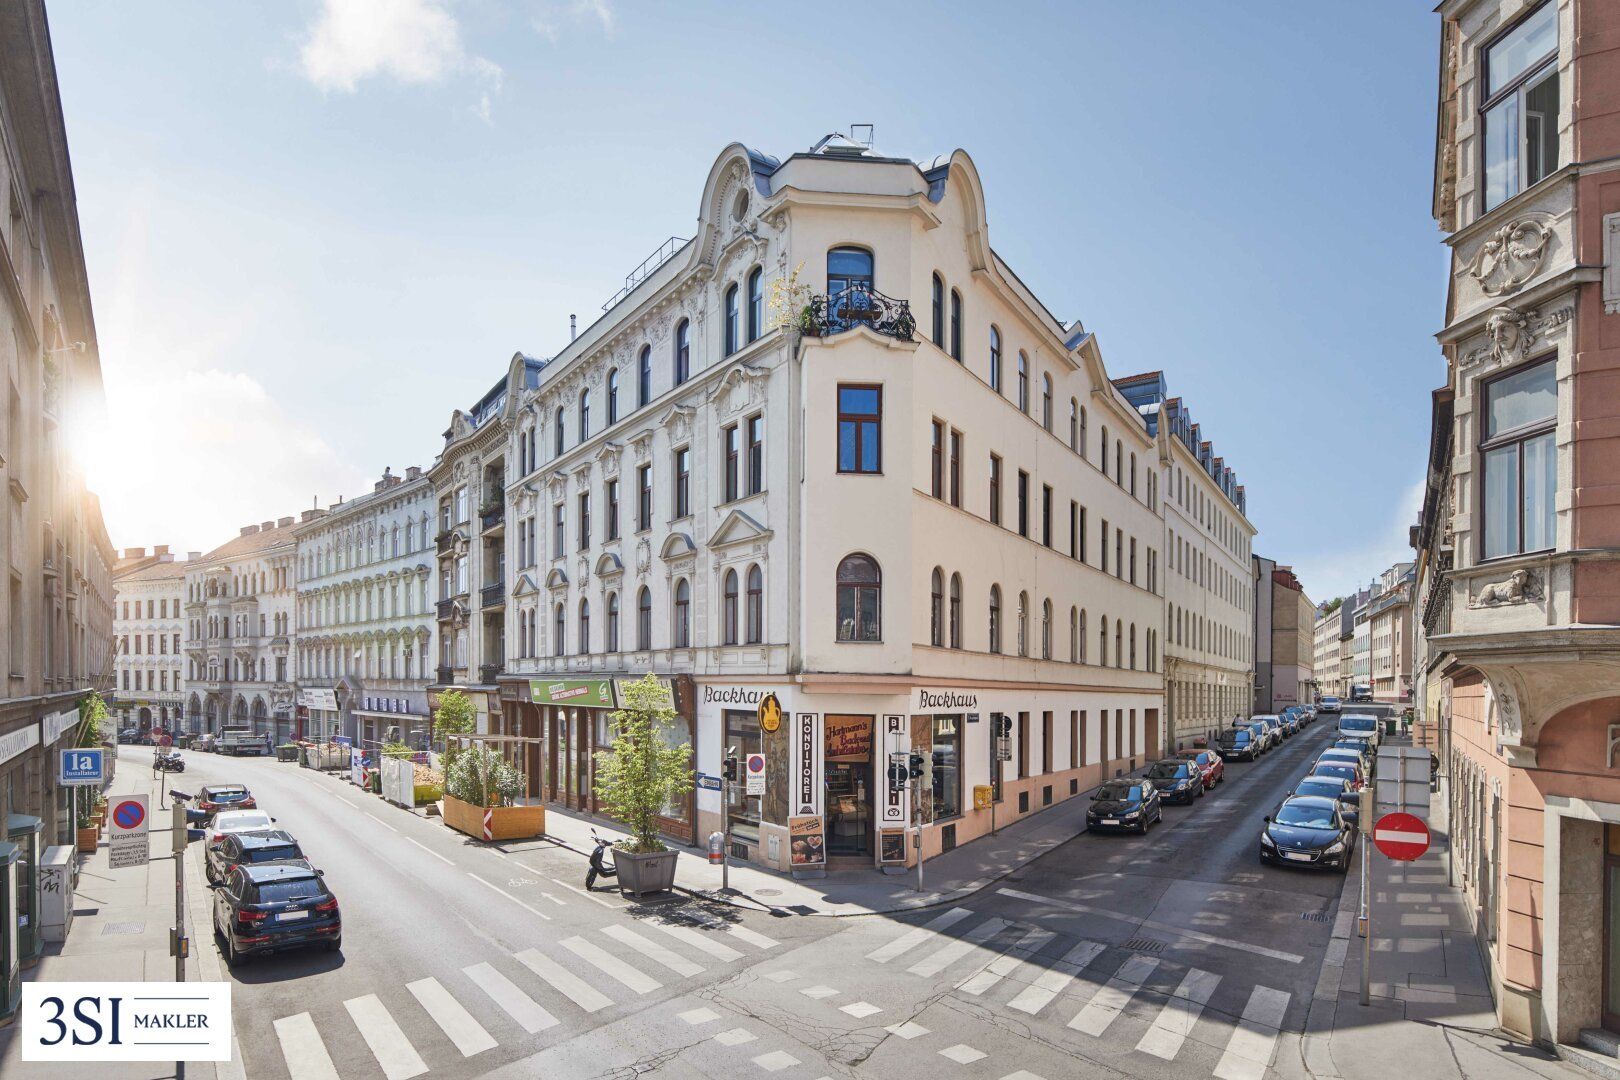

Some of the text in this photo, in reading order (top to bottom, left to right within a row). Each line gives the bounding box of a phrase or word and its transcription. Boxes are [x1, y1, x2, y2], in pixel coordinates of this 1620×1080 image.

[919, 689, 978, 709] Backhaus
[825, 722, 868, 741] Hartmann's
[71, 753, 93, 770] 1a
[803, 716, 811, 802] KONDITOREI
[111, 832, 147, 840] Kurzparkzone
